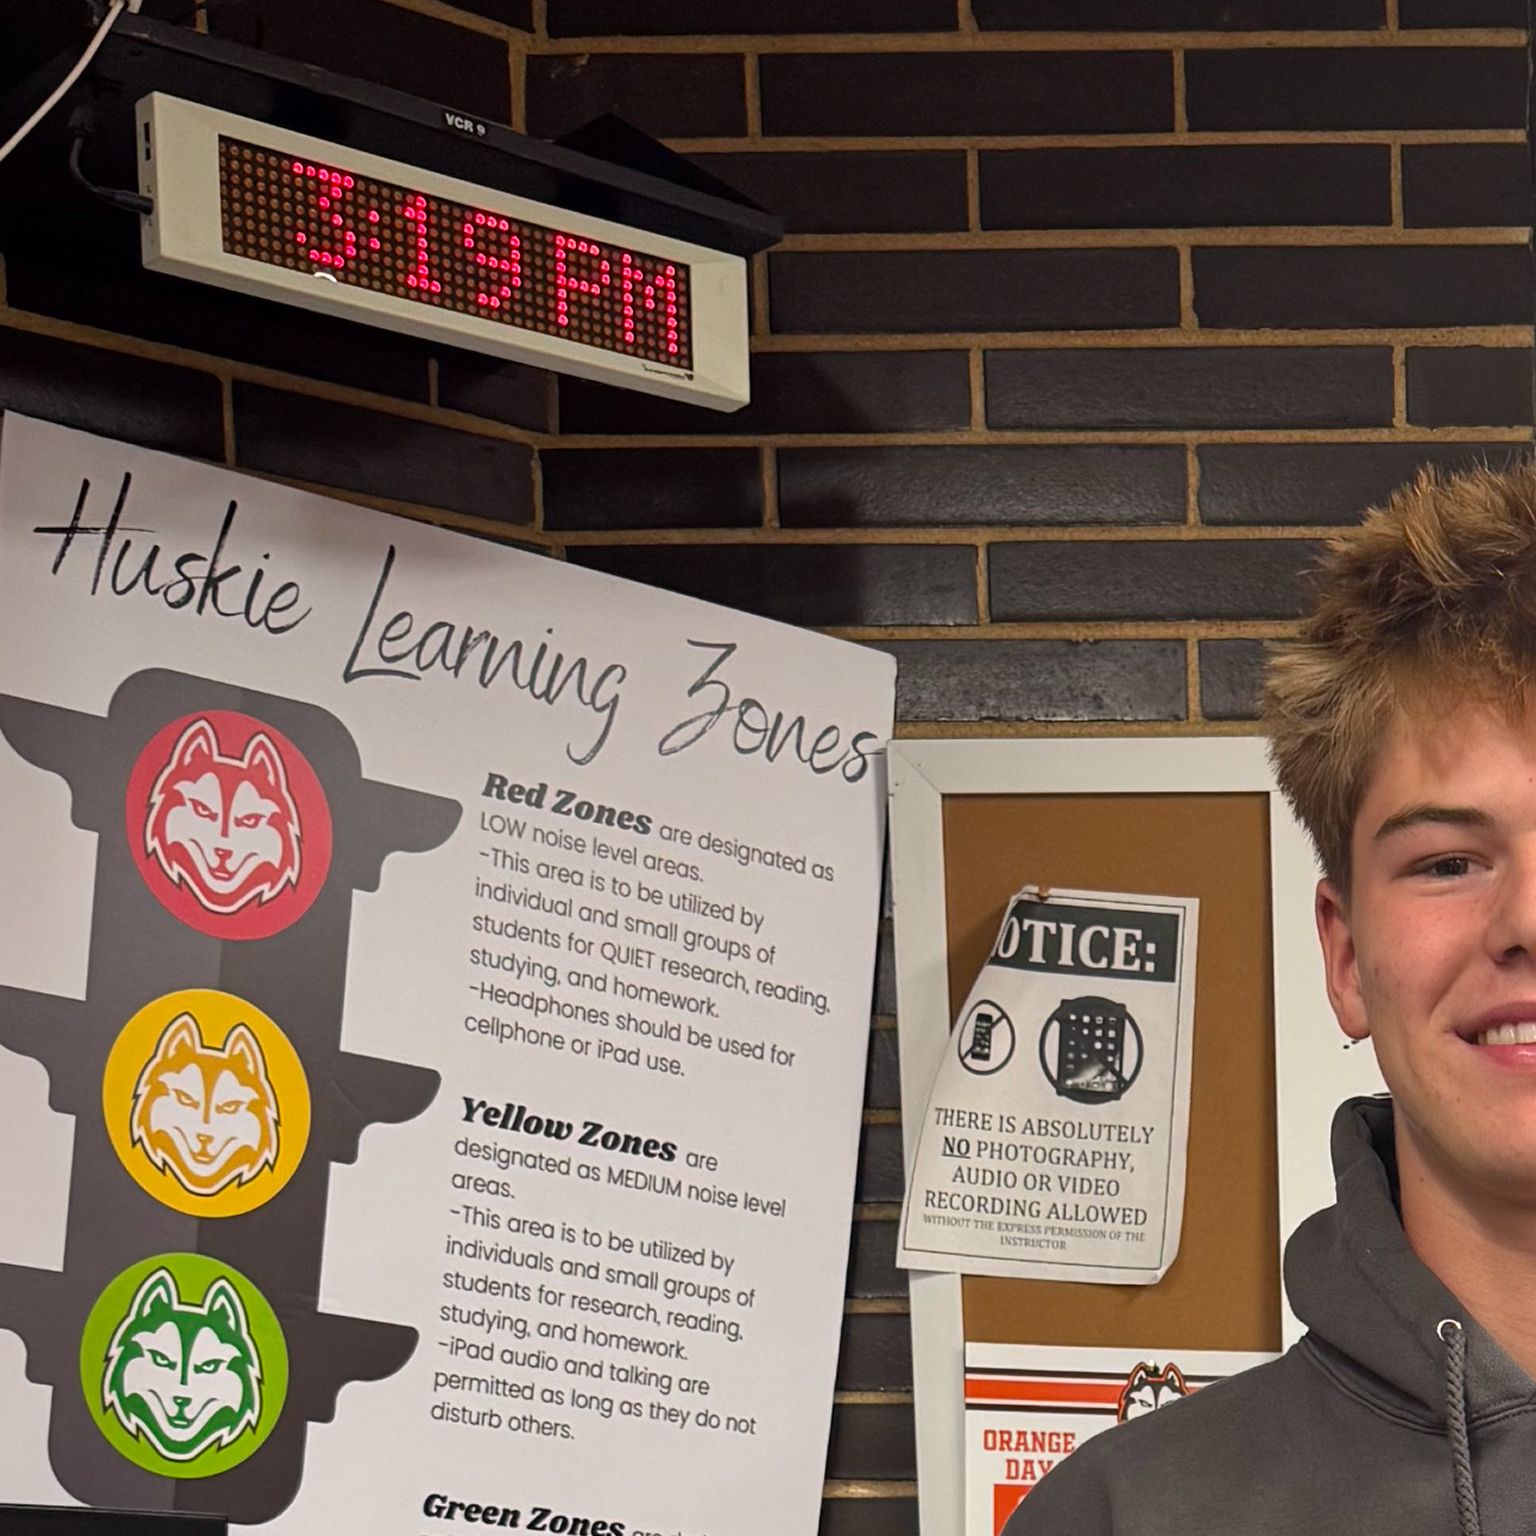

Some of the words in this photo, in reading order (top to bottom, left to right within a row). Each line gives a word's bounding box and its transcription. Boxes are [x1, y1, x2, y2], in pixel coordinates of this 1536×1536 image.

[445, 112, 474, 133] VCR
[476, 124, 486, 137] 9
[292, 161, 521, 309] 3:19
[555, 234, 678, 354] PM
[33, 471, 313, 635] Huskie
[343, 544, 628, 767] Learning
[658, 640, 887, 783] Zones
[480, 811, 527, 839] LOW
[532, 827, 587, 854] noise
[592, 837, 637, 866] level
[643, 854, 704, 882] areas.
[481, 772, 549, 810] Red
[550, 789, 653, 835] Zones
[659, 825, 692, 846] are
[697, 832, 807, 875] designated
[811, 863, 834, 882] as
[473, 914, 561, 949] students
[567, 932, 595, 956] for
[600, 941, 656, 969] QUIET
[661, 958, 750, 995] research,
[755, 979, 830, 1016] reading,
[990, 916, 1156, 973] OTICE:
[470, 948, 561, 988] studying,
[567, 970, 608, 993] and
[613, 975, 719, 1018] homework.
[464, 1016, 566, 1050] cellphone
[570, 1038, 592, 1056] or
[597, 1038, 641, 1066] iPad
[646, 1054, 685, 1076] use.
[469, 981, 610, 1027] -Headphones
[615, 1012, 682, 1042] should
[686, 1025, 713, 1049] be
[717, 1037, 765, 1061] used
[770, 1044, 796, 1067] for
[461, 1096, 574, 1141] Yellow
[577, 1120, 678, 1162] Zones
[685, 1152, 718, 1172] are
[935, 1107, 993, 1131] THERE
[998, 1114, 1016, 1134] IS
[1020, 1118, 1155, 1145] ABSOLUTELY
[941, 1136, 971, 1160] NO
[976, 1139, 1135, 1173] PHOTOGRAPHY,
[451, 1173, 515, 1199] areas.
[454, 1137, 572, 1176] designated
[576, 1163, 601, 1182] as
[607, 1166, 682, 1197] MEDIUM
[687, 1184, 738, 1208] noise
[743, 1192, 786, 1218] level
[951, 1165, 1018, 1189] AUDIO
[1023, 1172, 1052, 1192] OR
[1057, 1175, 1120, 1197] VIDEO
[923, 1214, 971, 1228] WITHOUT
[973, 1219, 994, 1230] THE
[997, 1221, 1042, 1234] EXPRESS
[1044, 1226, 1106, 1239] PERMISSION
[1109, 1231, 1122, 1240] OF
[1125, 1231, 1144, 1242] THE
[925, 1189, 1041, 1218] RECORDING
[1046, 1202, 1148, 1226] ALLOWED
[1000, 1235, 1066, 1250] INSTRUCTOR
[438, 1335, 495, 1362] -iPad
[499, 1348, 559, 1372] audio
[563, 1359, 604, 1379] and
[609, 1363, 673, 1396] talking
[677, 1377, 710, 1396] are
[430, 1401, 503, 1429] disturb
[507, 1414, 575, 1440] others.
[433, 1371, 535, 1401] permitted
[540, 1388, 565, 1406] as
[570, 1388, 614, 1419] long
[618, 1400, 643, 1418] as
[649, 1401, 691, 1429] they
[694, 1409, 721, 1429] do
[725, 1416, 757, 1435] not
[983, 1429, 1076, 1453] ORANGE
[1005, 1458, 1054, 1480] DAY
[422, 1493, 521, 1529] Green
